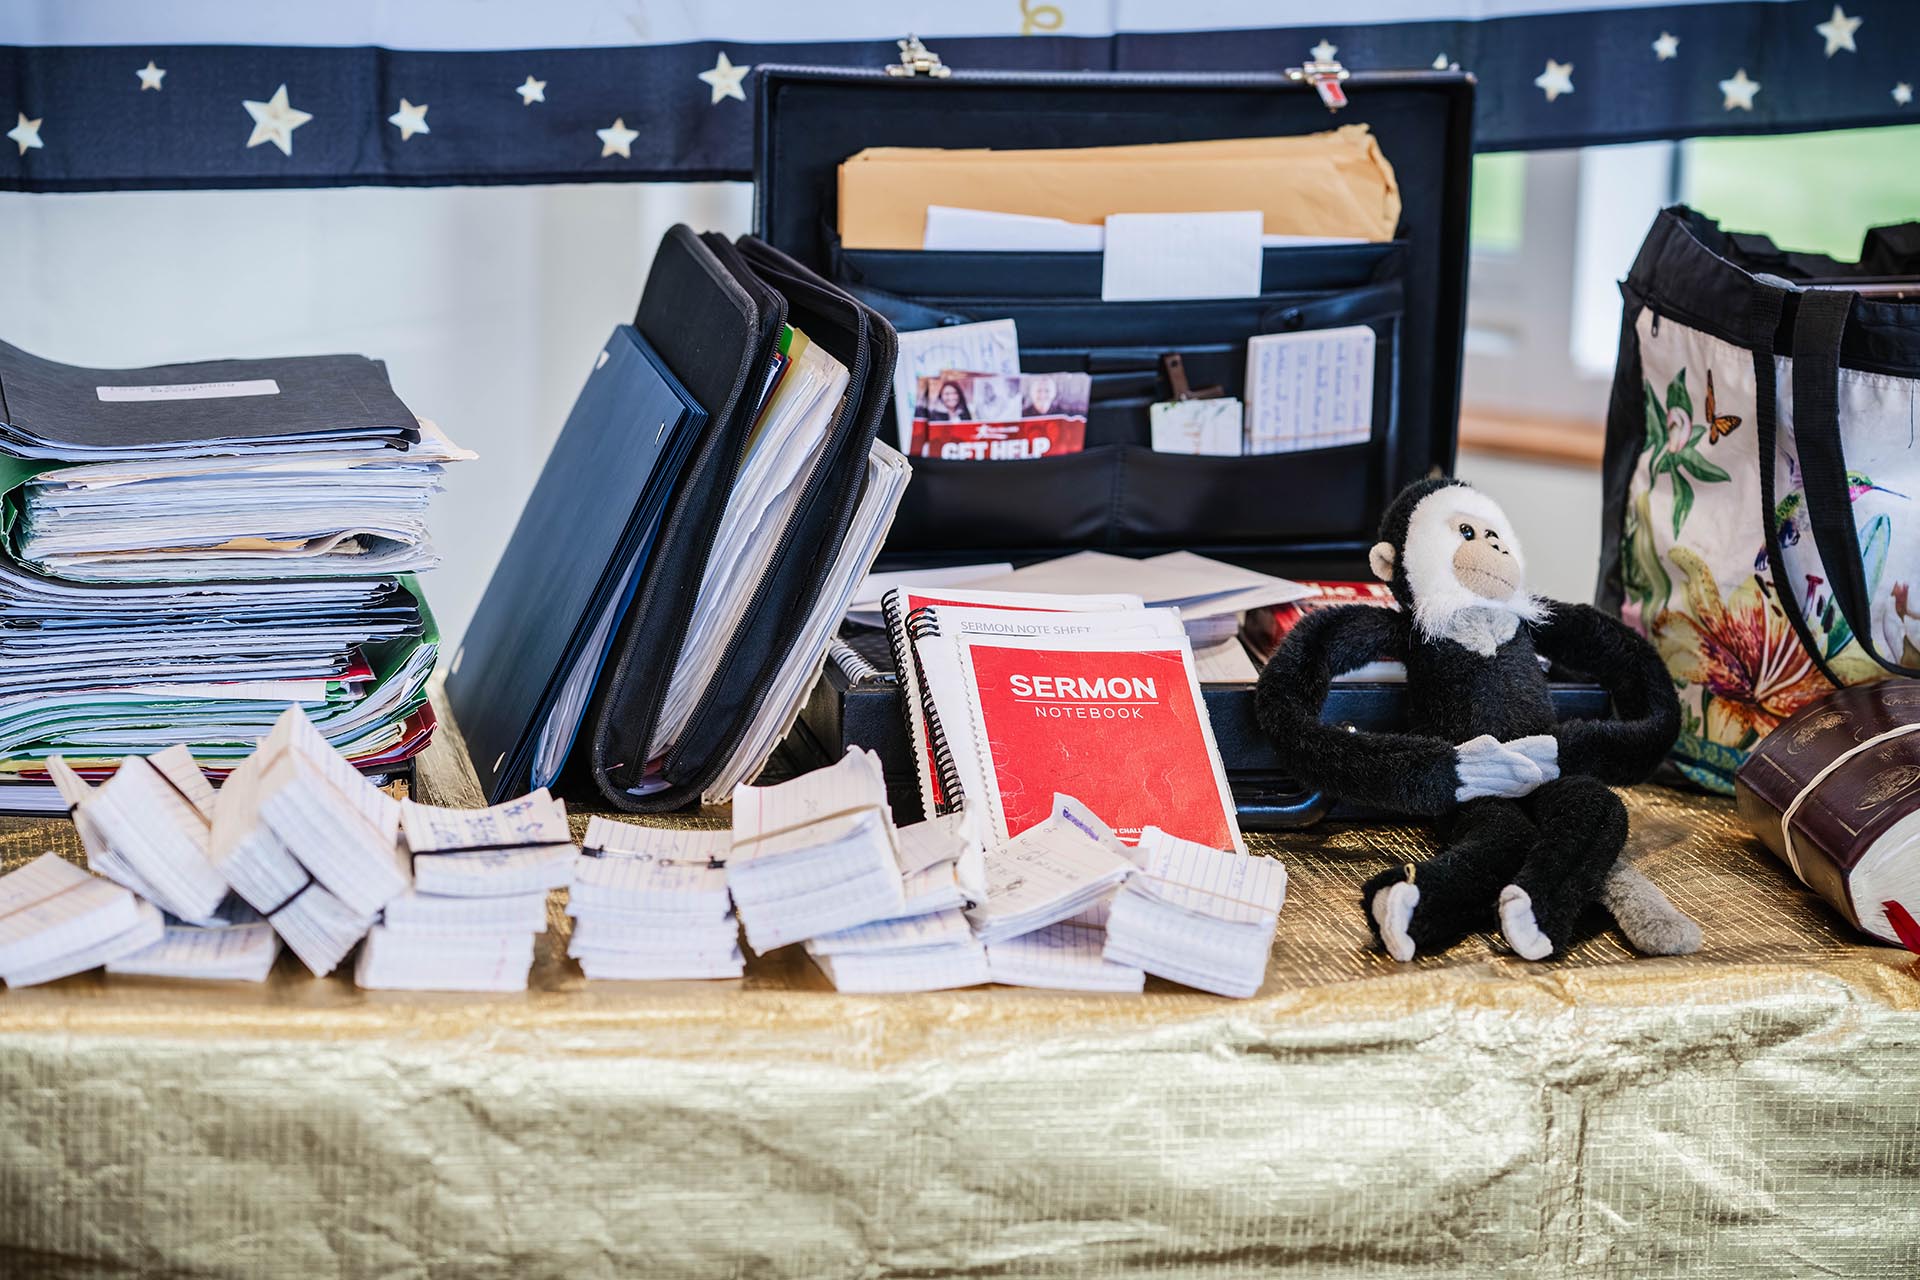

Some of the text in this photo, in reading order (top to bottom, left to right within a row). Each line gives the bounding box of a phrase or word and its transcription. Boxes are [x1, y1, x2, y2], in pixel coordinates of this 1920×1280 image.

[960, 621, 1014, 634] SERMON
[1016, 625, 1051, 635] NOTE
[1009, 674, 1158, 699] SERMON
[1035, 706, 1144, 719] NOTEBOOK
